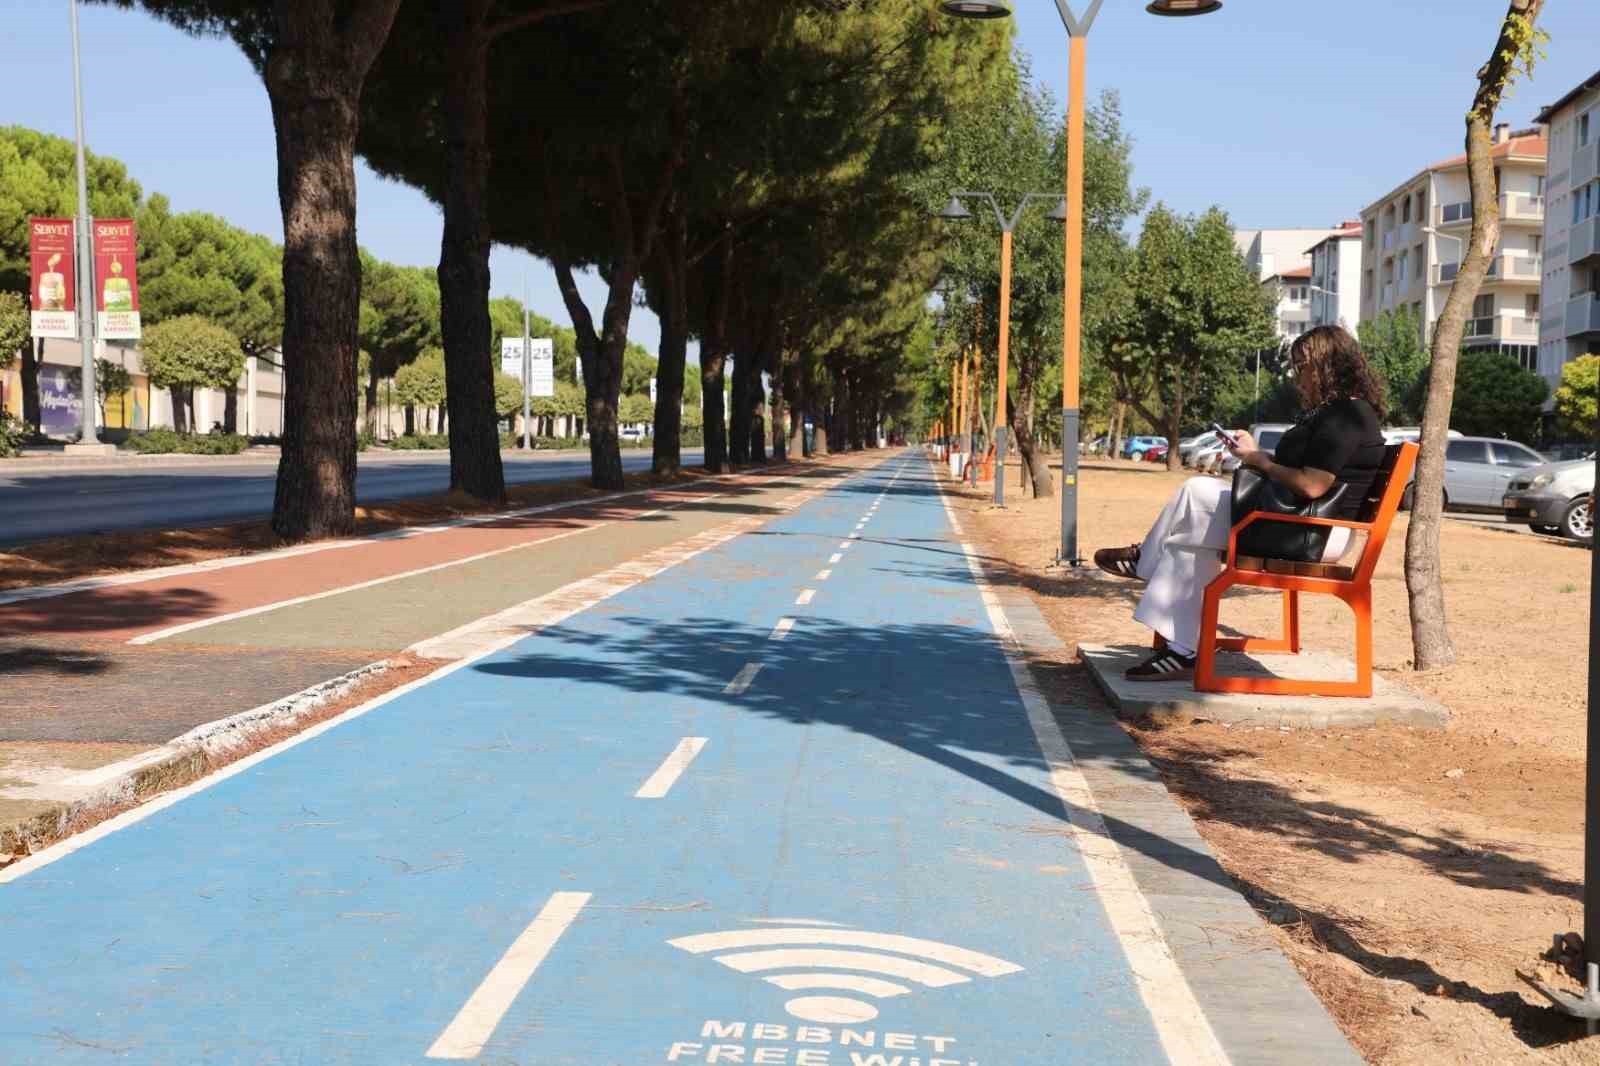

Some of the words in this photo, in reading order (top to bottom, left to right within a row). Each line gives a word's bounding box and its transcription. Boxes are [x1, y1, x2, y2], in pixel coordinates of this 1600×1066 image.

[33, 223, 68, 235] SERVET
[97, 225, 131, 236] SERVET
[503, 346, 521, 359] 25
[532, 347, 552, 360] 25
[701, 1020, 957, 1053] MBBNET
[667, 1042, 831, 1066] FREE
